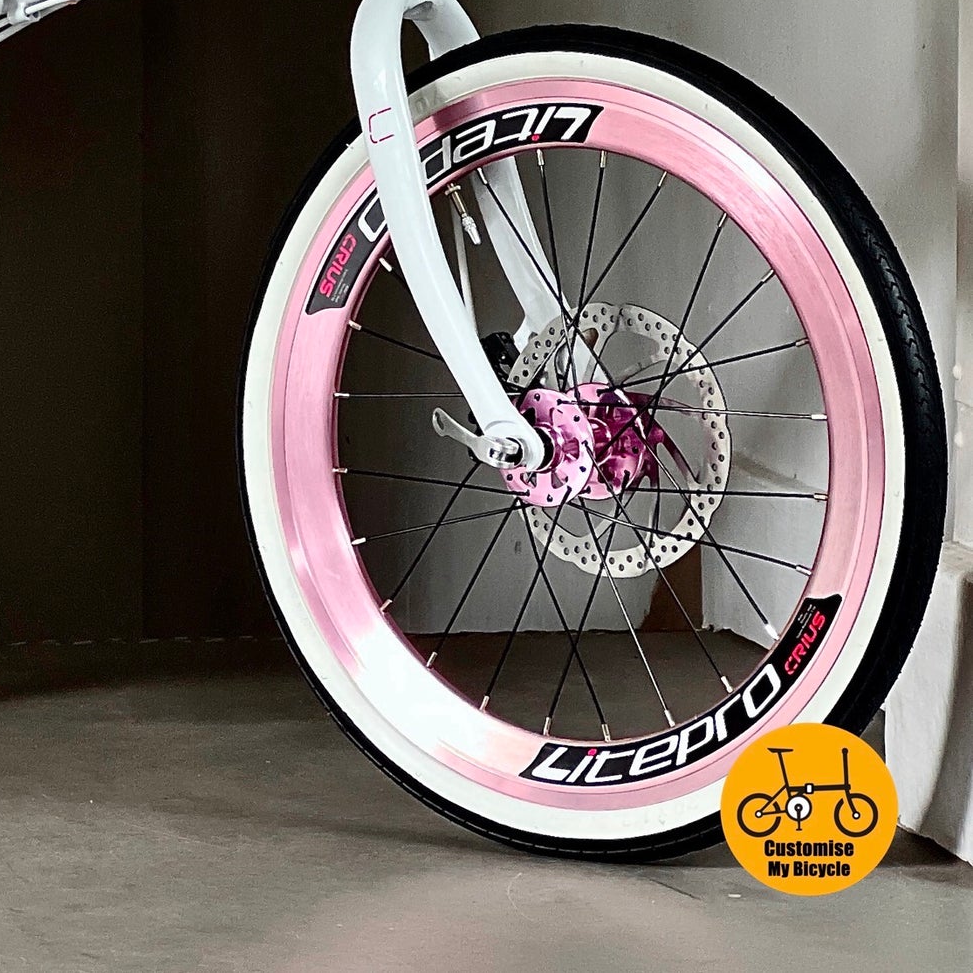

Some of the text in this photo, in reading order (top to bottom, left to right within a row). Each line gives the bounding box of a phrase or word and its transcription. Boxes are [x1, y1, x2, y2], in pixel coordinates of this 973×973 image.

[358, 106, 591, 243] Litepo
[318, 233, 357, 298] CRIUS
[784, 611, 826, 676] CRIUS
[531, 663, 781, 783] Litepro
